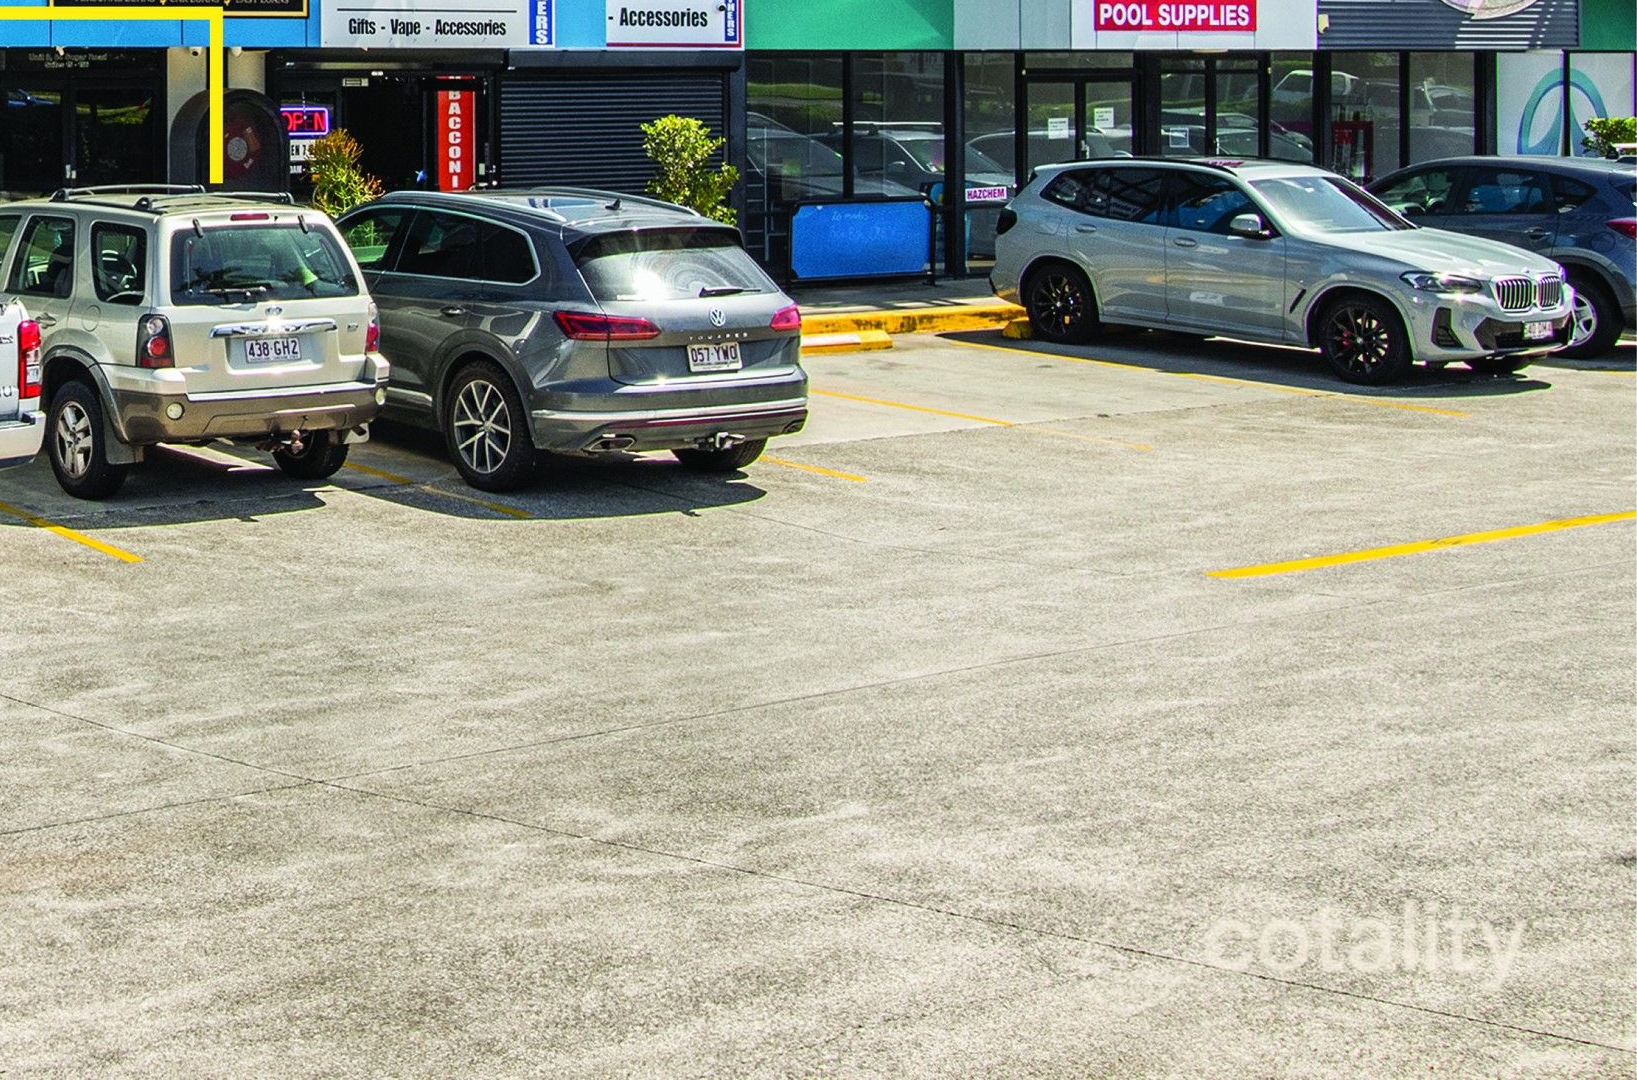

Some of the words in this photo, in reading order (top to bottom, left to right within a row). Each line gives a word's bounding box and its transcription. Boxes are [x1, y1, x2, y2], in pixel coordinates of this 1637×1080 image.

[620, 7, 708, 28] Accessories
[1100, 3, 1154, 26] POOL
[1158, 4, 1249, 26] SUPPLIES
[348, 18, 376, 35] Gifts
[390, 19, 421, 37] Vape
[435, 18, 507, 36] Accessories
[967, 188, 1005, 201] HAZCHEM
